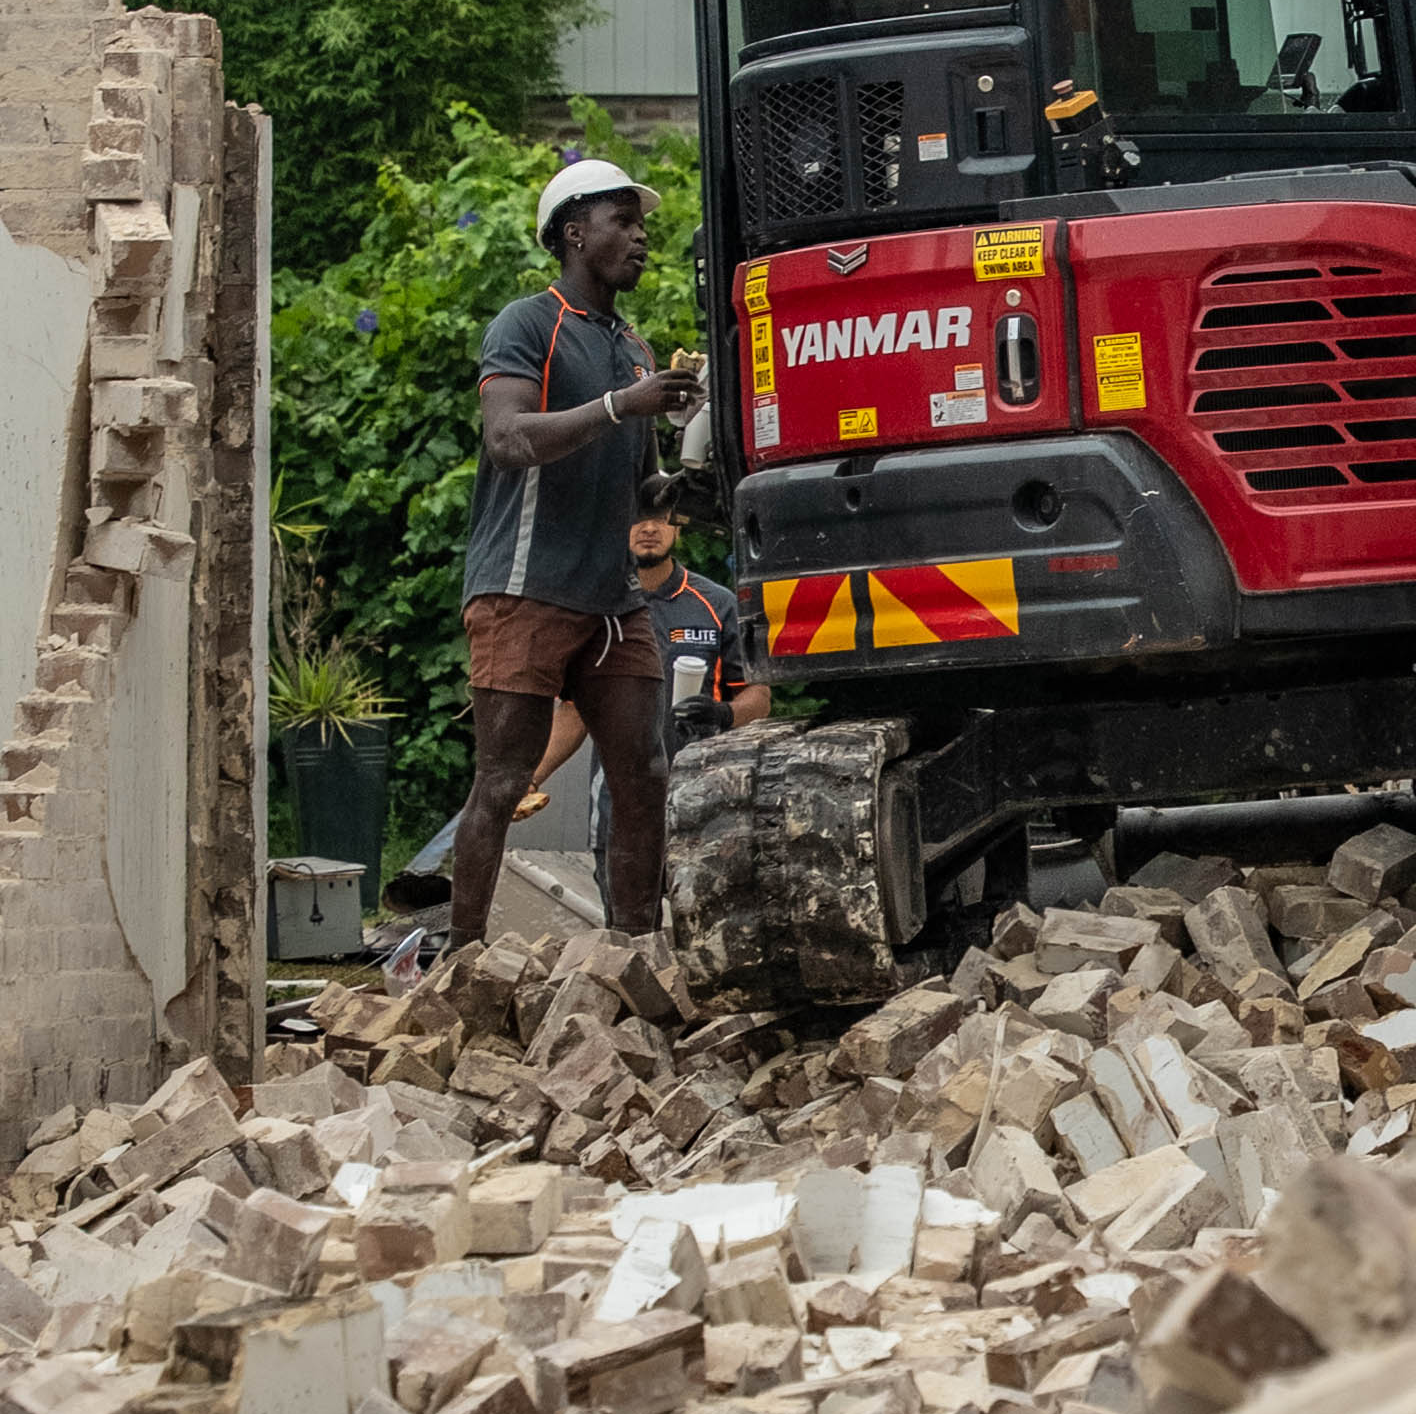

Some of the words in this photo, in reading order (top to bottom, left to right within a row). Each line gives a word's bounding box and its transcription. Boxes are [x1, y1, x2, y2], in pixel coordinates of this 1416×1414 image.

[989, 228, 1041, 244] WARNING
[978, 249, 998, 261] KEEP
[1000, 247, 1026, 260] CLEAR
[1029, 246, 1039, 258] OF
[983, 262, 1010, 275] SWING
[1012, 260, 1035, 273] AREA
[754, 322, 768, 341] LEFT
[781, 306, 973, 368] YANMAR
[684, 629, 717, 641] ELITE
